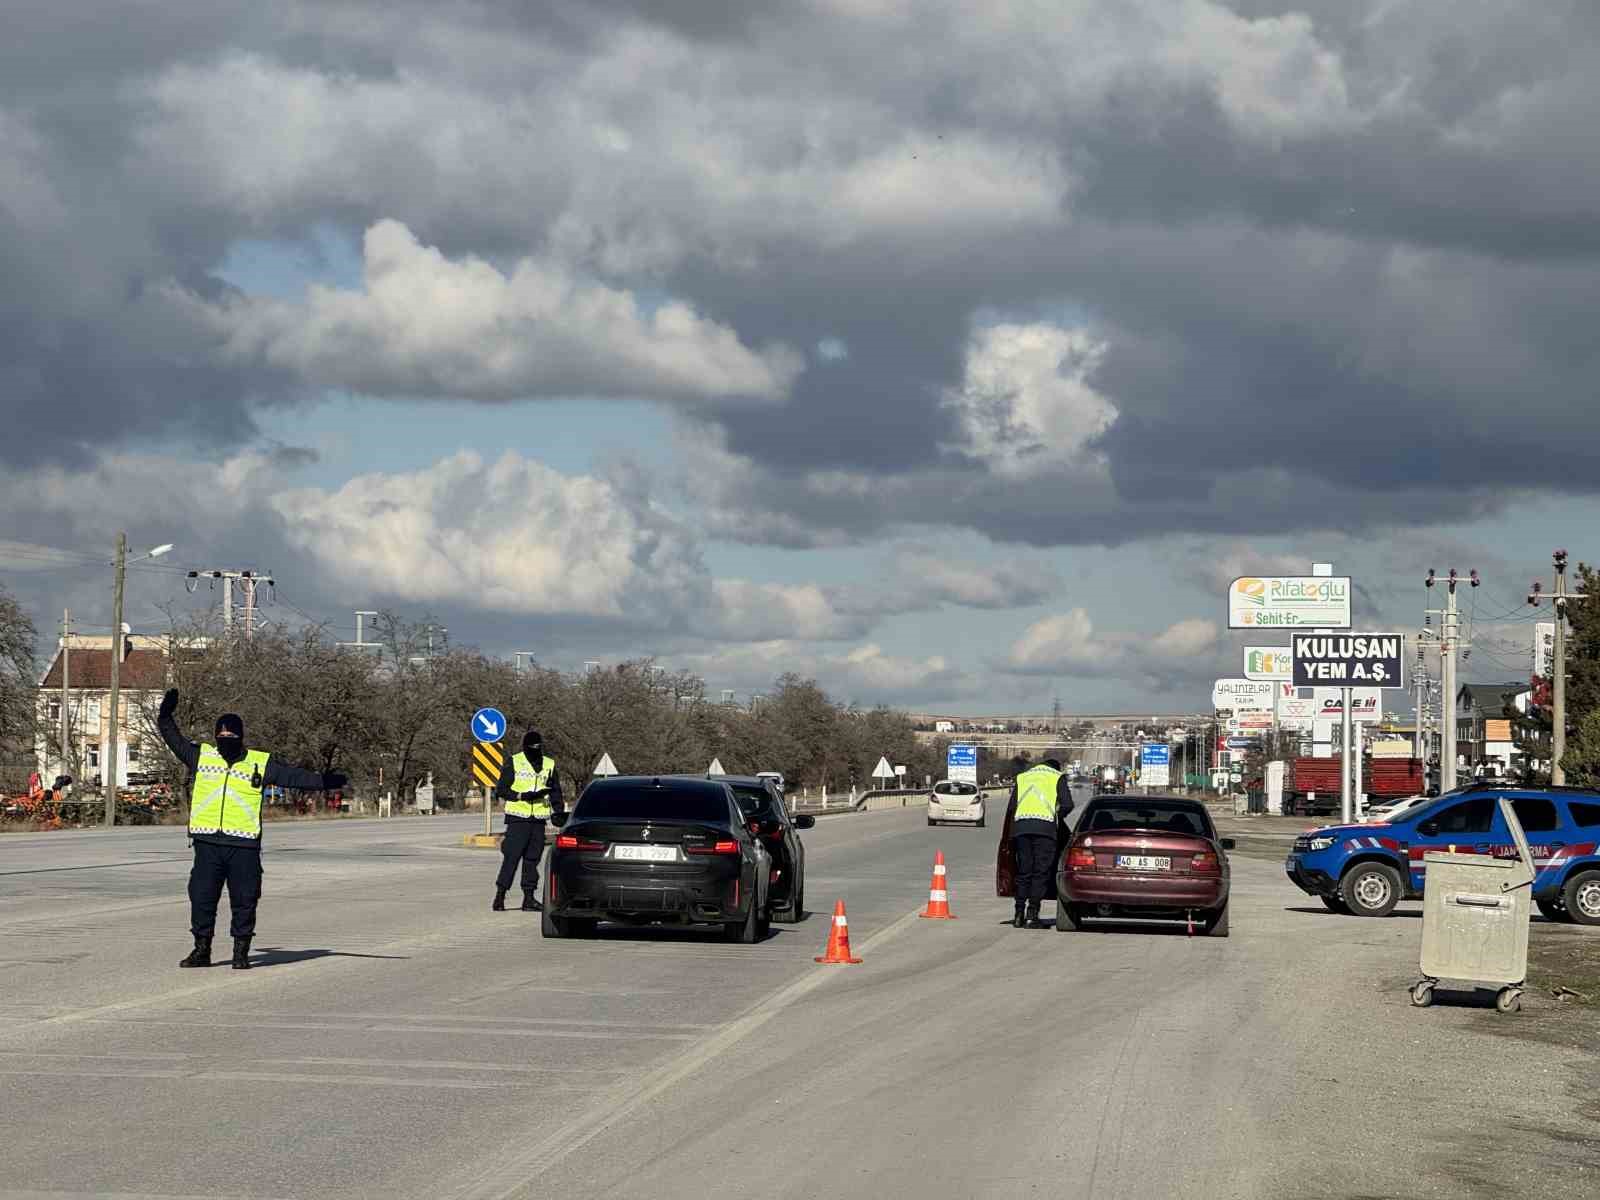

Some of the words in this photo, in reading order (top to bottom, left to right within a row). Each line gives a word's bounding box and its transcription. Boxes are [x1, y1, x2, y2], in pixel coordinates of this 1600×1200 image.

[1296, 638, 1397, 659] KULUSAN
[1303, 662, 1347, 680] YEM
[1352, 662, 1391, 682] A.Ş.
[1323, 699, 1362, 708] CAE
[1497, 845, 1550, 857] JANRMA
[1121, 857, 1131, 865] 40
